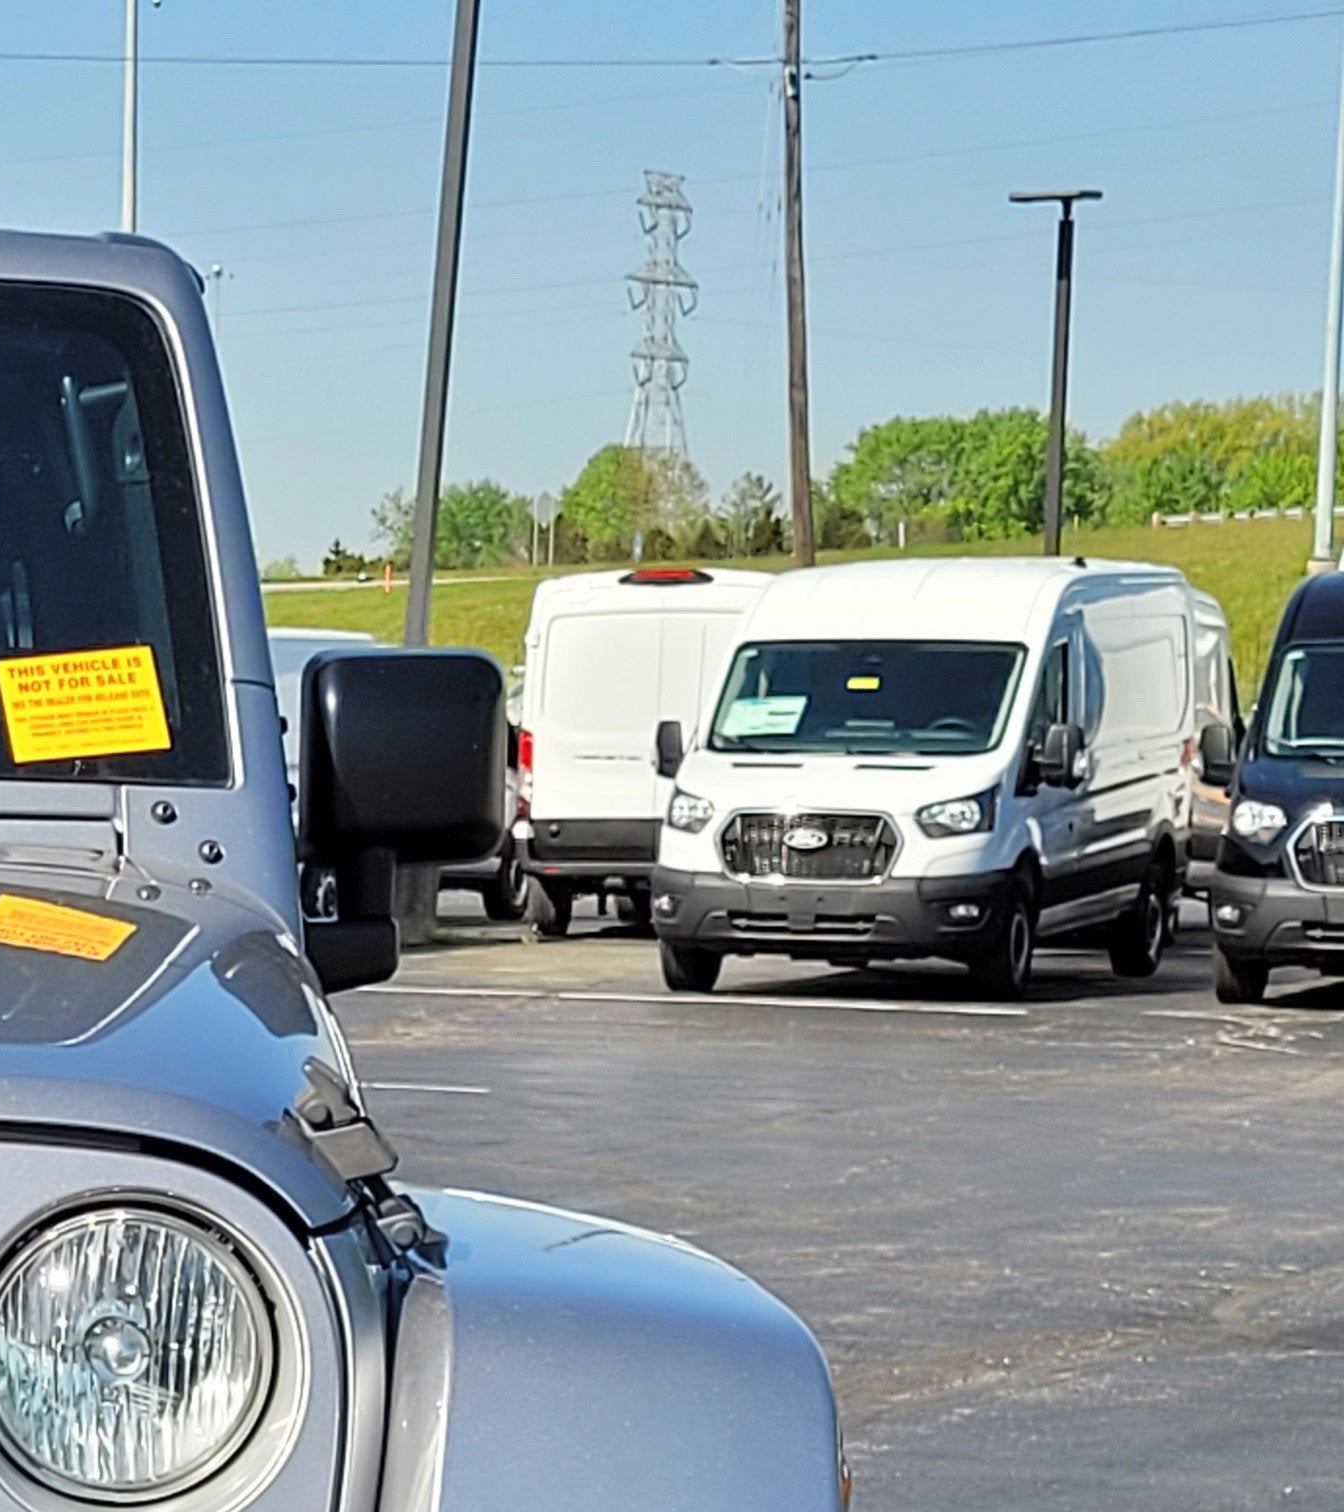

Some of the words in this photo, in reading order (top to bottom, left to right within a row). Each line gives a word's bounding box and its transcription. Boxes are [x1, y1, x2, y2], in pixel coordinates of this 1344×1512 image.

[7, 665, 46, 679] THIS
[51, 658, 121, 675] VEHICLE
[127, 656, 142, 668] IS
[18, 680, 51, 693] NOT
[58, 676, 90, 690] FOR
[96, 672, 137, 687] SALE
[28, 698, 43, 708] THE
[45, 696, 75, 706] DEALER
[78, 694, 93, 703] FOR
